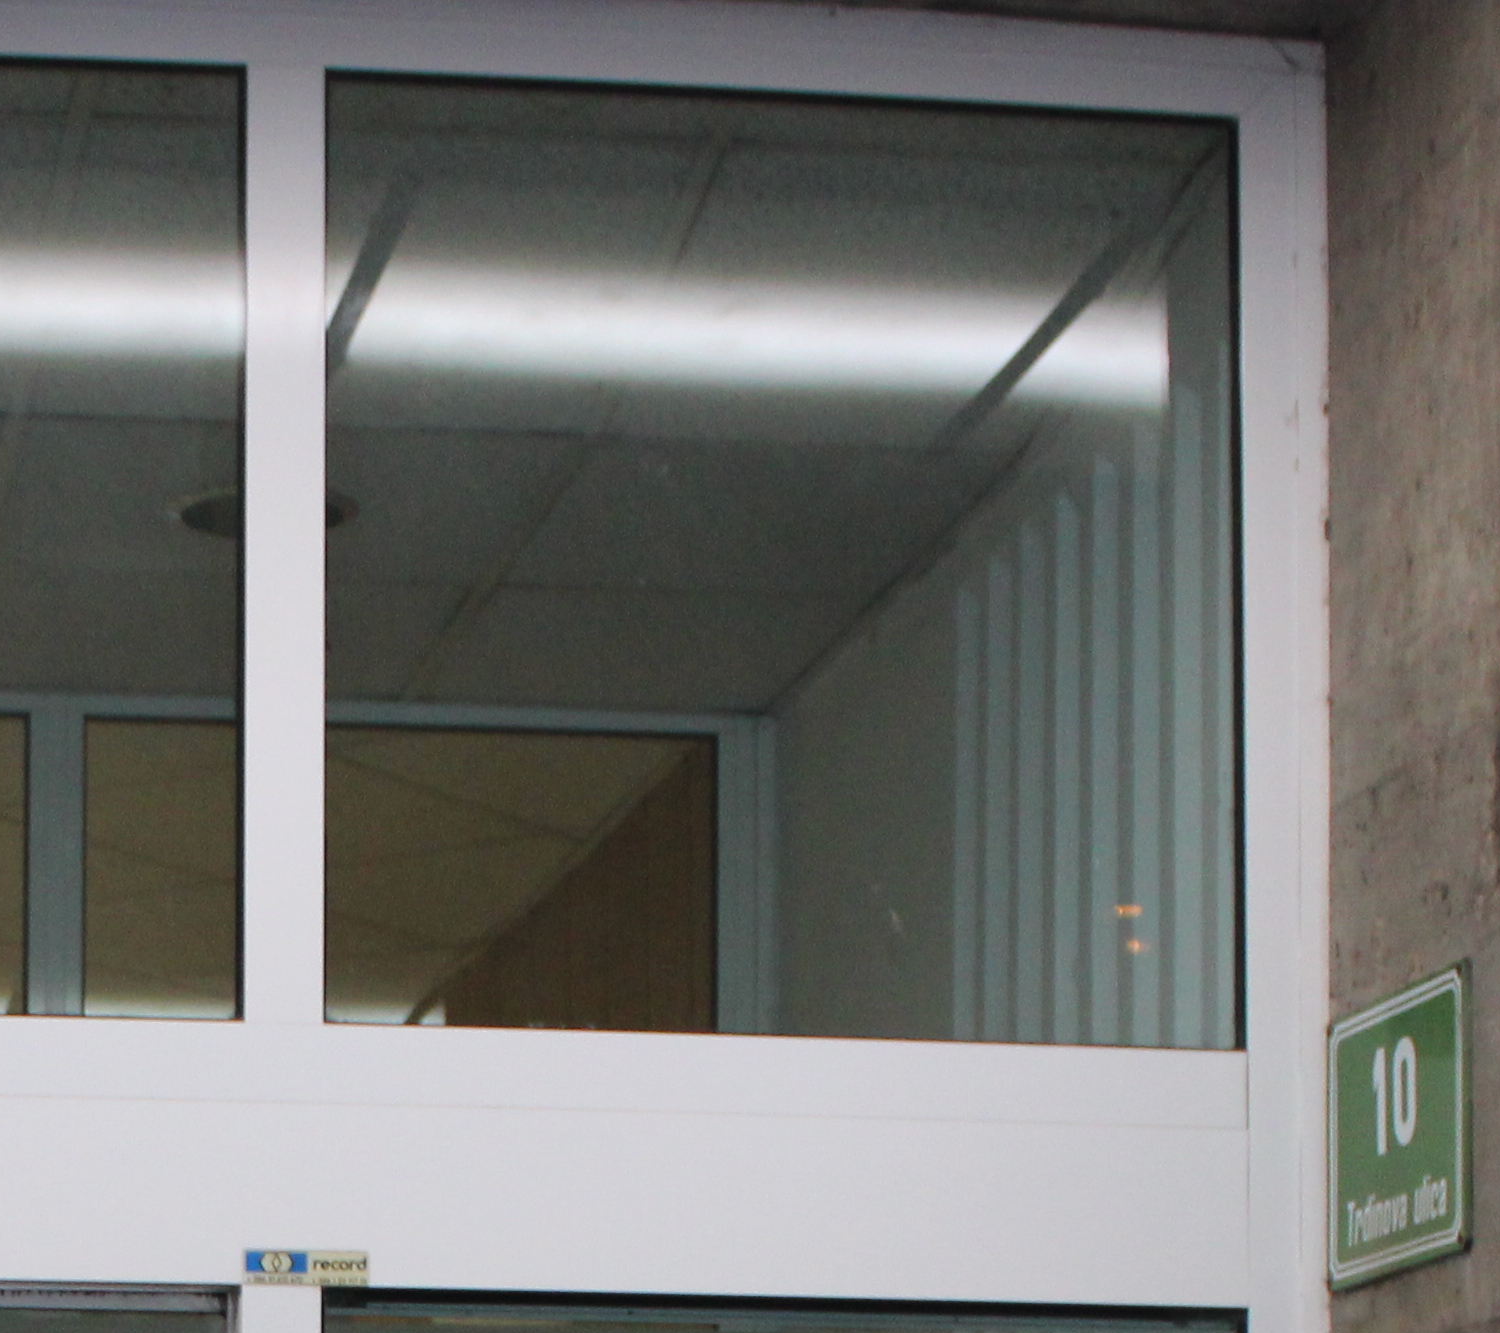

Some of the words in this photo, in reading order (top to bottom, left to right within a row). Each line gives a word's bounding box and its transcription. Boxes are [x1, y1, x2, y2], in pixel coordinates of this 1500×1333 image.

[1372, 1036, 1417, 1156] 10
[1347, 1193, 1408, 1247] Trdinova
[1412, 1175, 1447, 1226] ulica
[312, 1256, 368, 1272] record
